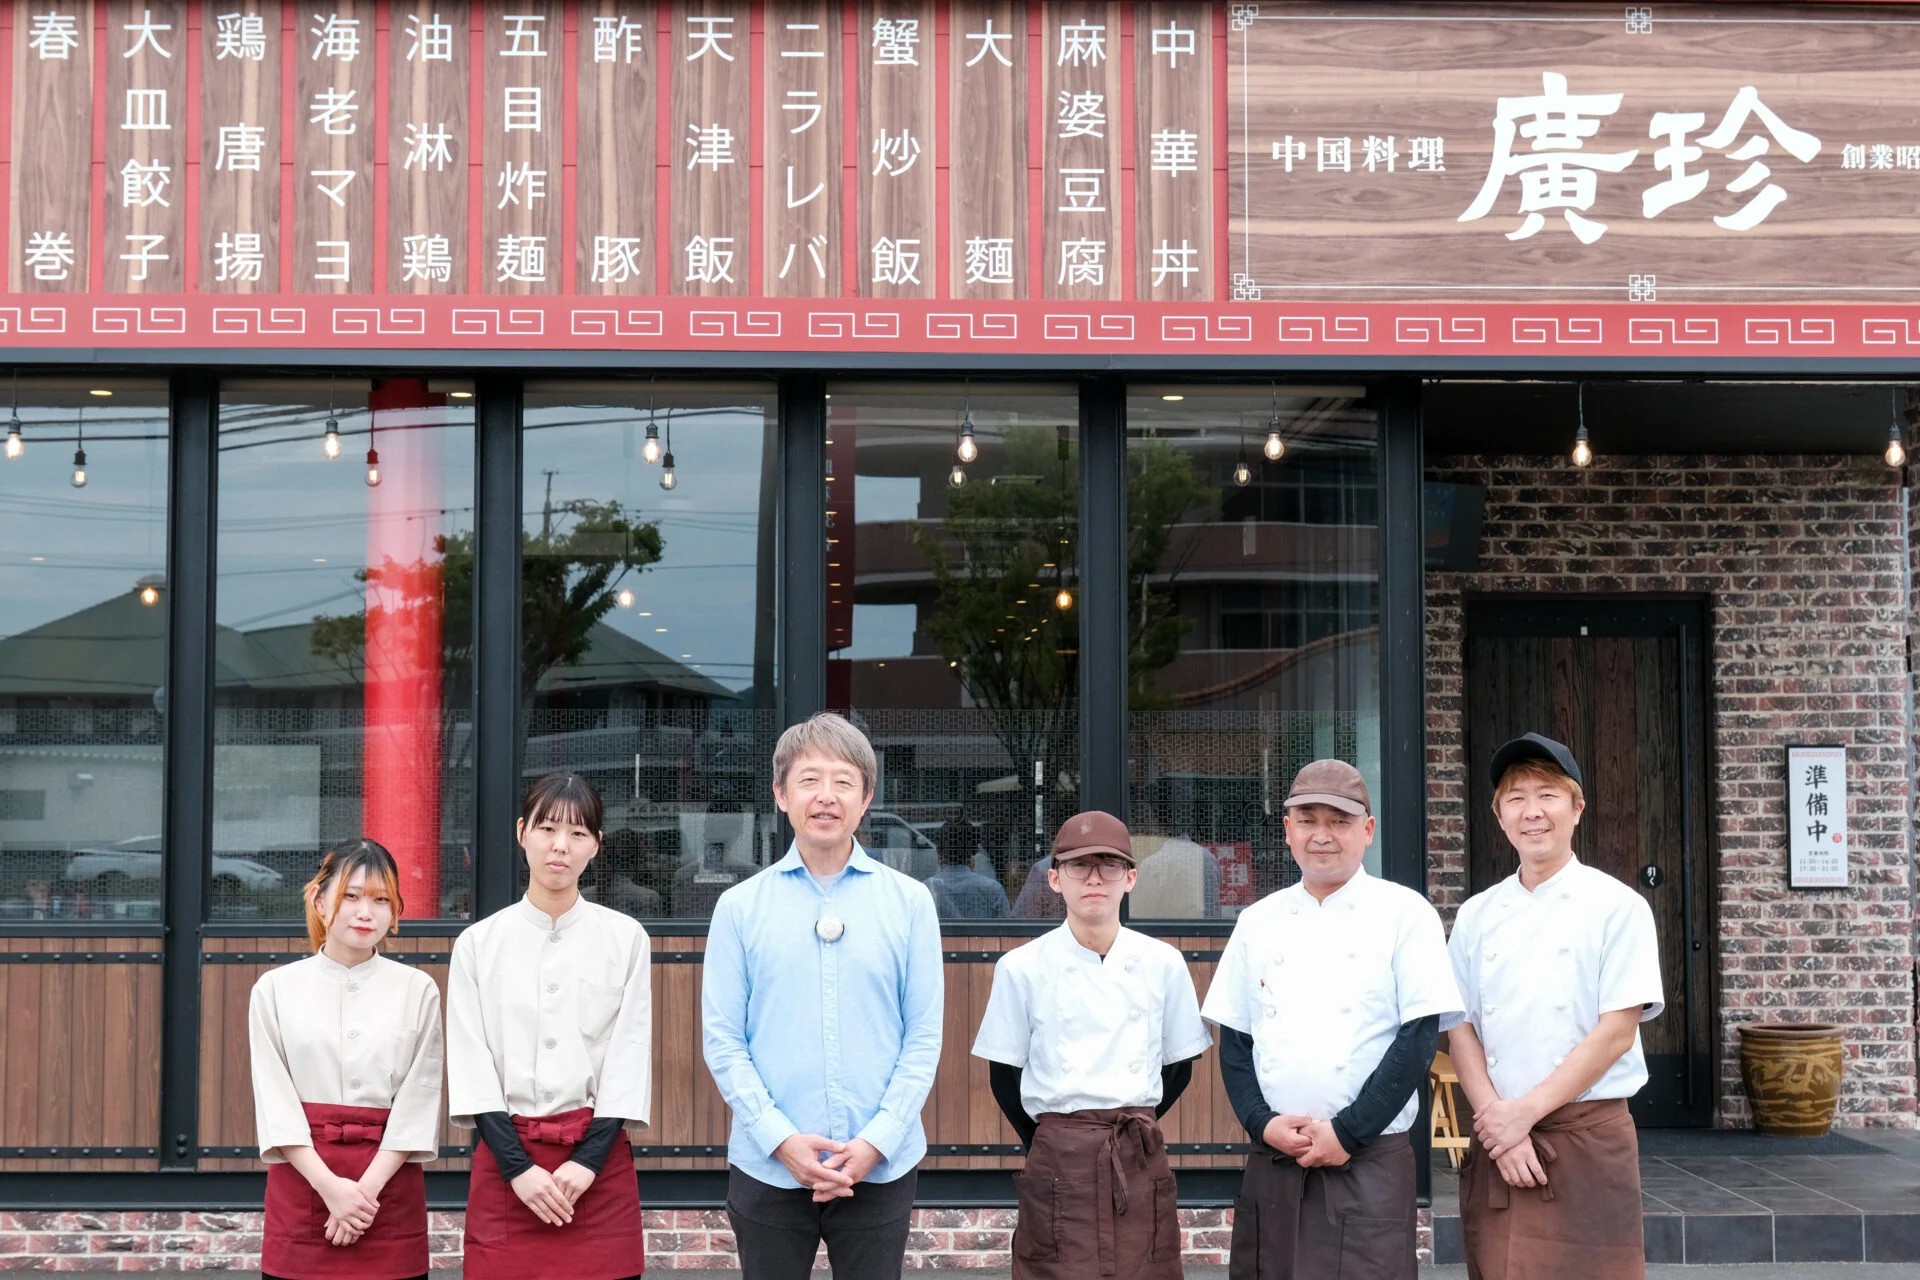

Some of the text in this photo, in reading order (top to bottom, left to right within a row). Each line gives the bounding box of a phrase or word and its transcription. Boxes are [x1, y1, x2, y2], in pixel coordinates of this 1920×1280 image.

[25, 12, 79, 280] 春巻
[119, 11, 172, 281] 大皿餃子
[214, 13, 266, 281] 鶏唐揚
[310, 14, 360, 282] 海老マヨ
[402, 14, 453, 283] 油淋鶏
[496, 15, 548, 283] 五目炸麺
[591, 16, 642, 283] 酢豚
[685, 17, 736, 284] 天津飯
[778, 23, 828, 281] ニラレバ
[871, 18, 921, 285] 蟹炒飯
[1057, 19, 1106, 286] 麻婆豆腐
[1150, 20, 1199, 288] 中華丼
[1271, 135, 1446, 173] 中国料理
[1458, 71, 1822, 245] 廣珍
[1804, 764, 1829, 844] 準備中
